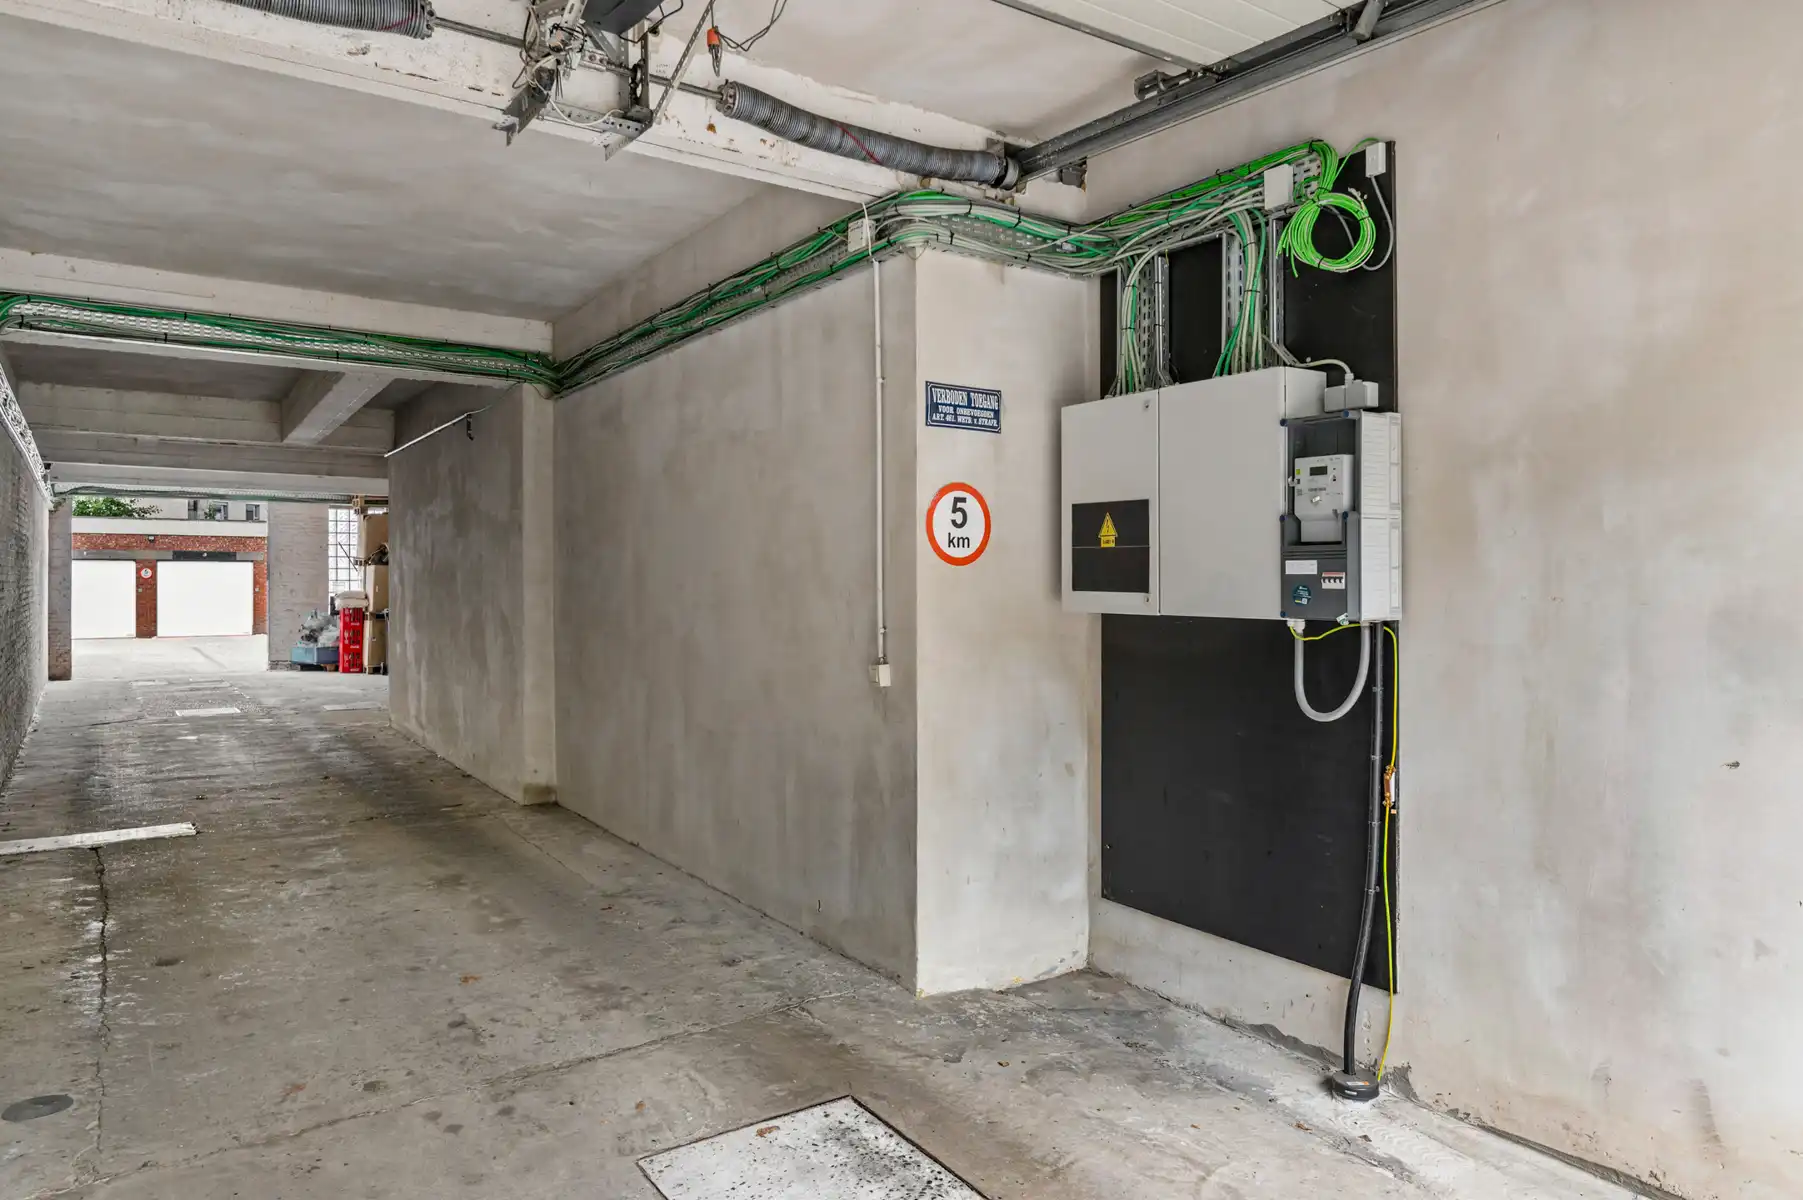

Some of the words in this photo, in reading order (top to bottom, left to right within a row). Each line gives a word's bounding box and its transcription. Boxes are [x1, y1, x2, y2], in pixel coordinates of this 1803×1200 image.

[932, 388, 968, 406] VERBODEN
[970, 392, 998, 410] TOEGANG
[938, 405, 954, 414] VOOR
[951, 497, 968, 529] 5
[948, 532, 970, 548] km
